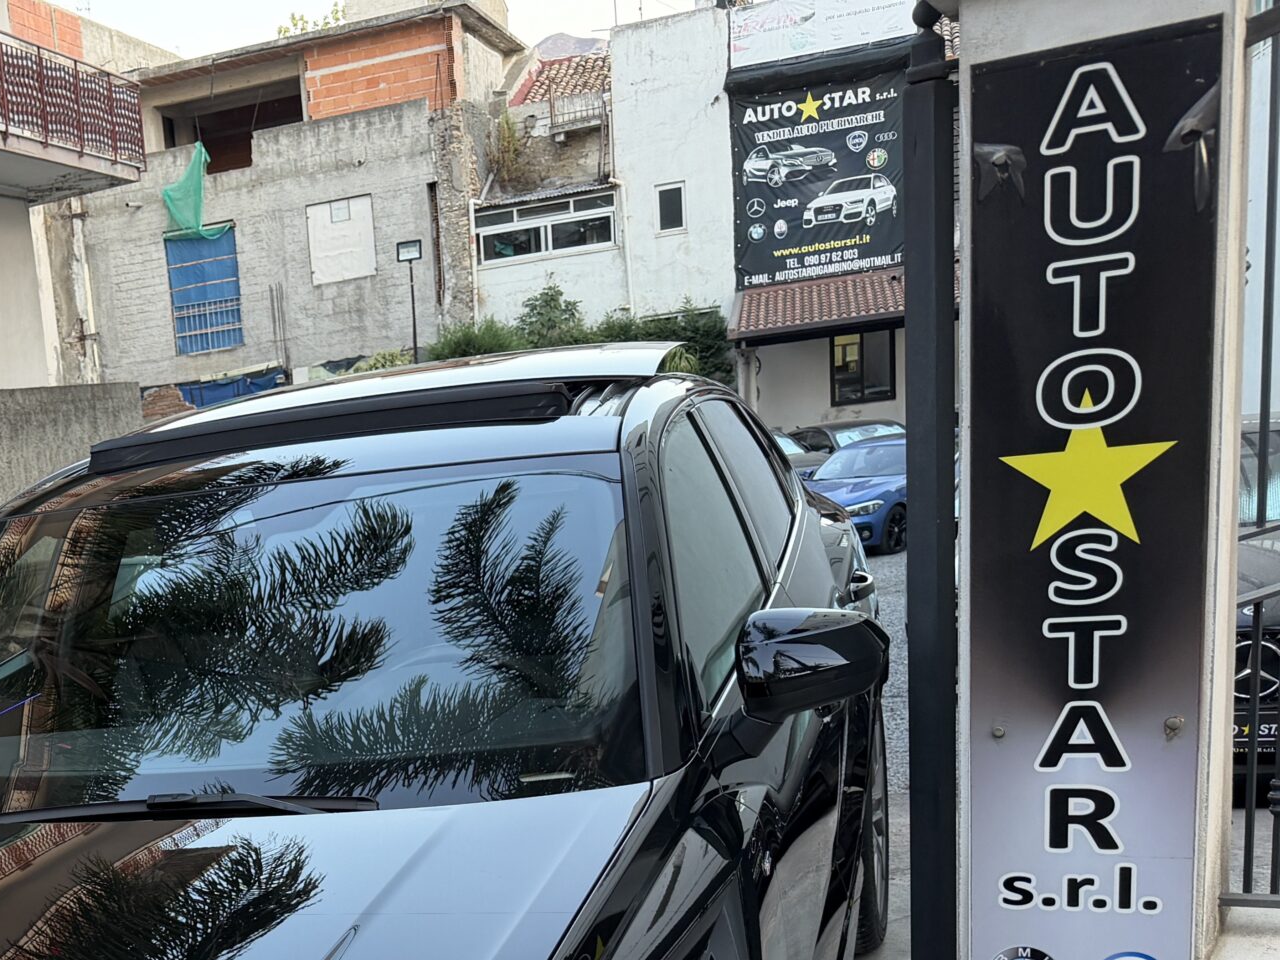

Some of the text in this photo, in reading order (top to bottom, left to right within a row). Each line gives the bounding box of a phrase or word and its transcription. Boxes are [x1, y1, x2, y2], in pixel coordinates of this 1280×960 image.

[743, 87, 898, 124] AUTO STAR s.r.l.
[755, 110, 885, 144] VENDITA AUTO PLURIMARCHE
[773, 199, 798, 208] Jeep
[773, 234, 871, 257] www.autostarsrl.it
[786, 258, 801, 269] TEL.
[804, 254, 819, 265] 090
[820, 253, 831, 264] 97
[832, 252, 842, 262] 62
[744, 275, 772, 286] E-MAIL:
[999, 61, 1163, 914] AUTO STAR s.r.l.
